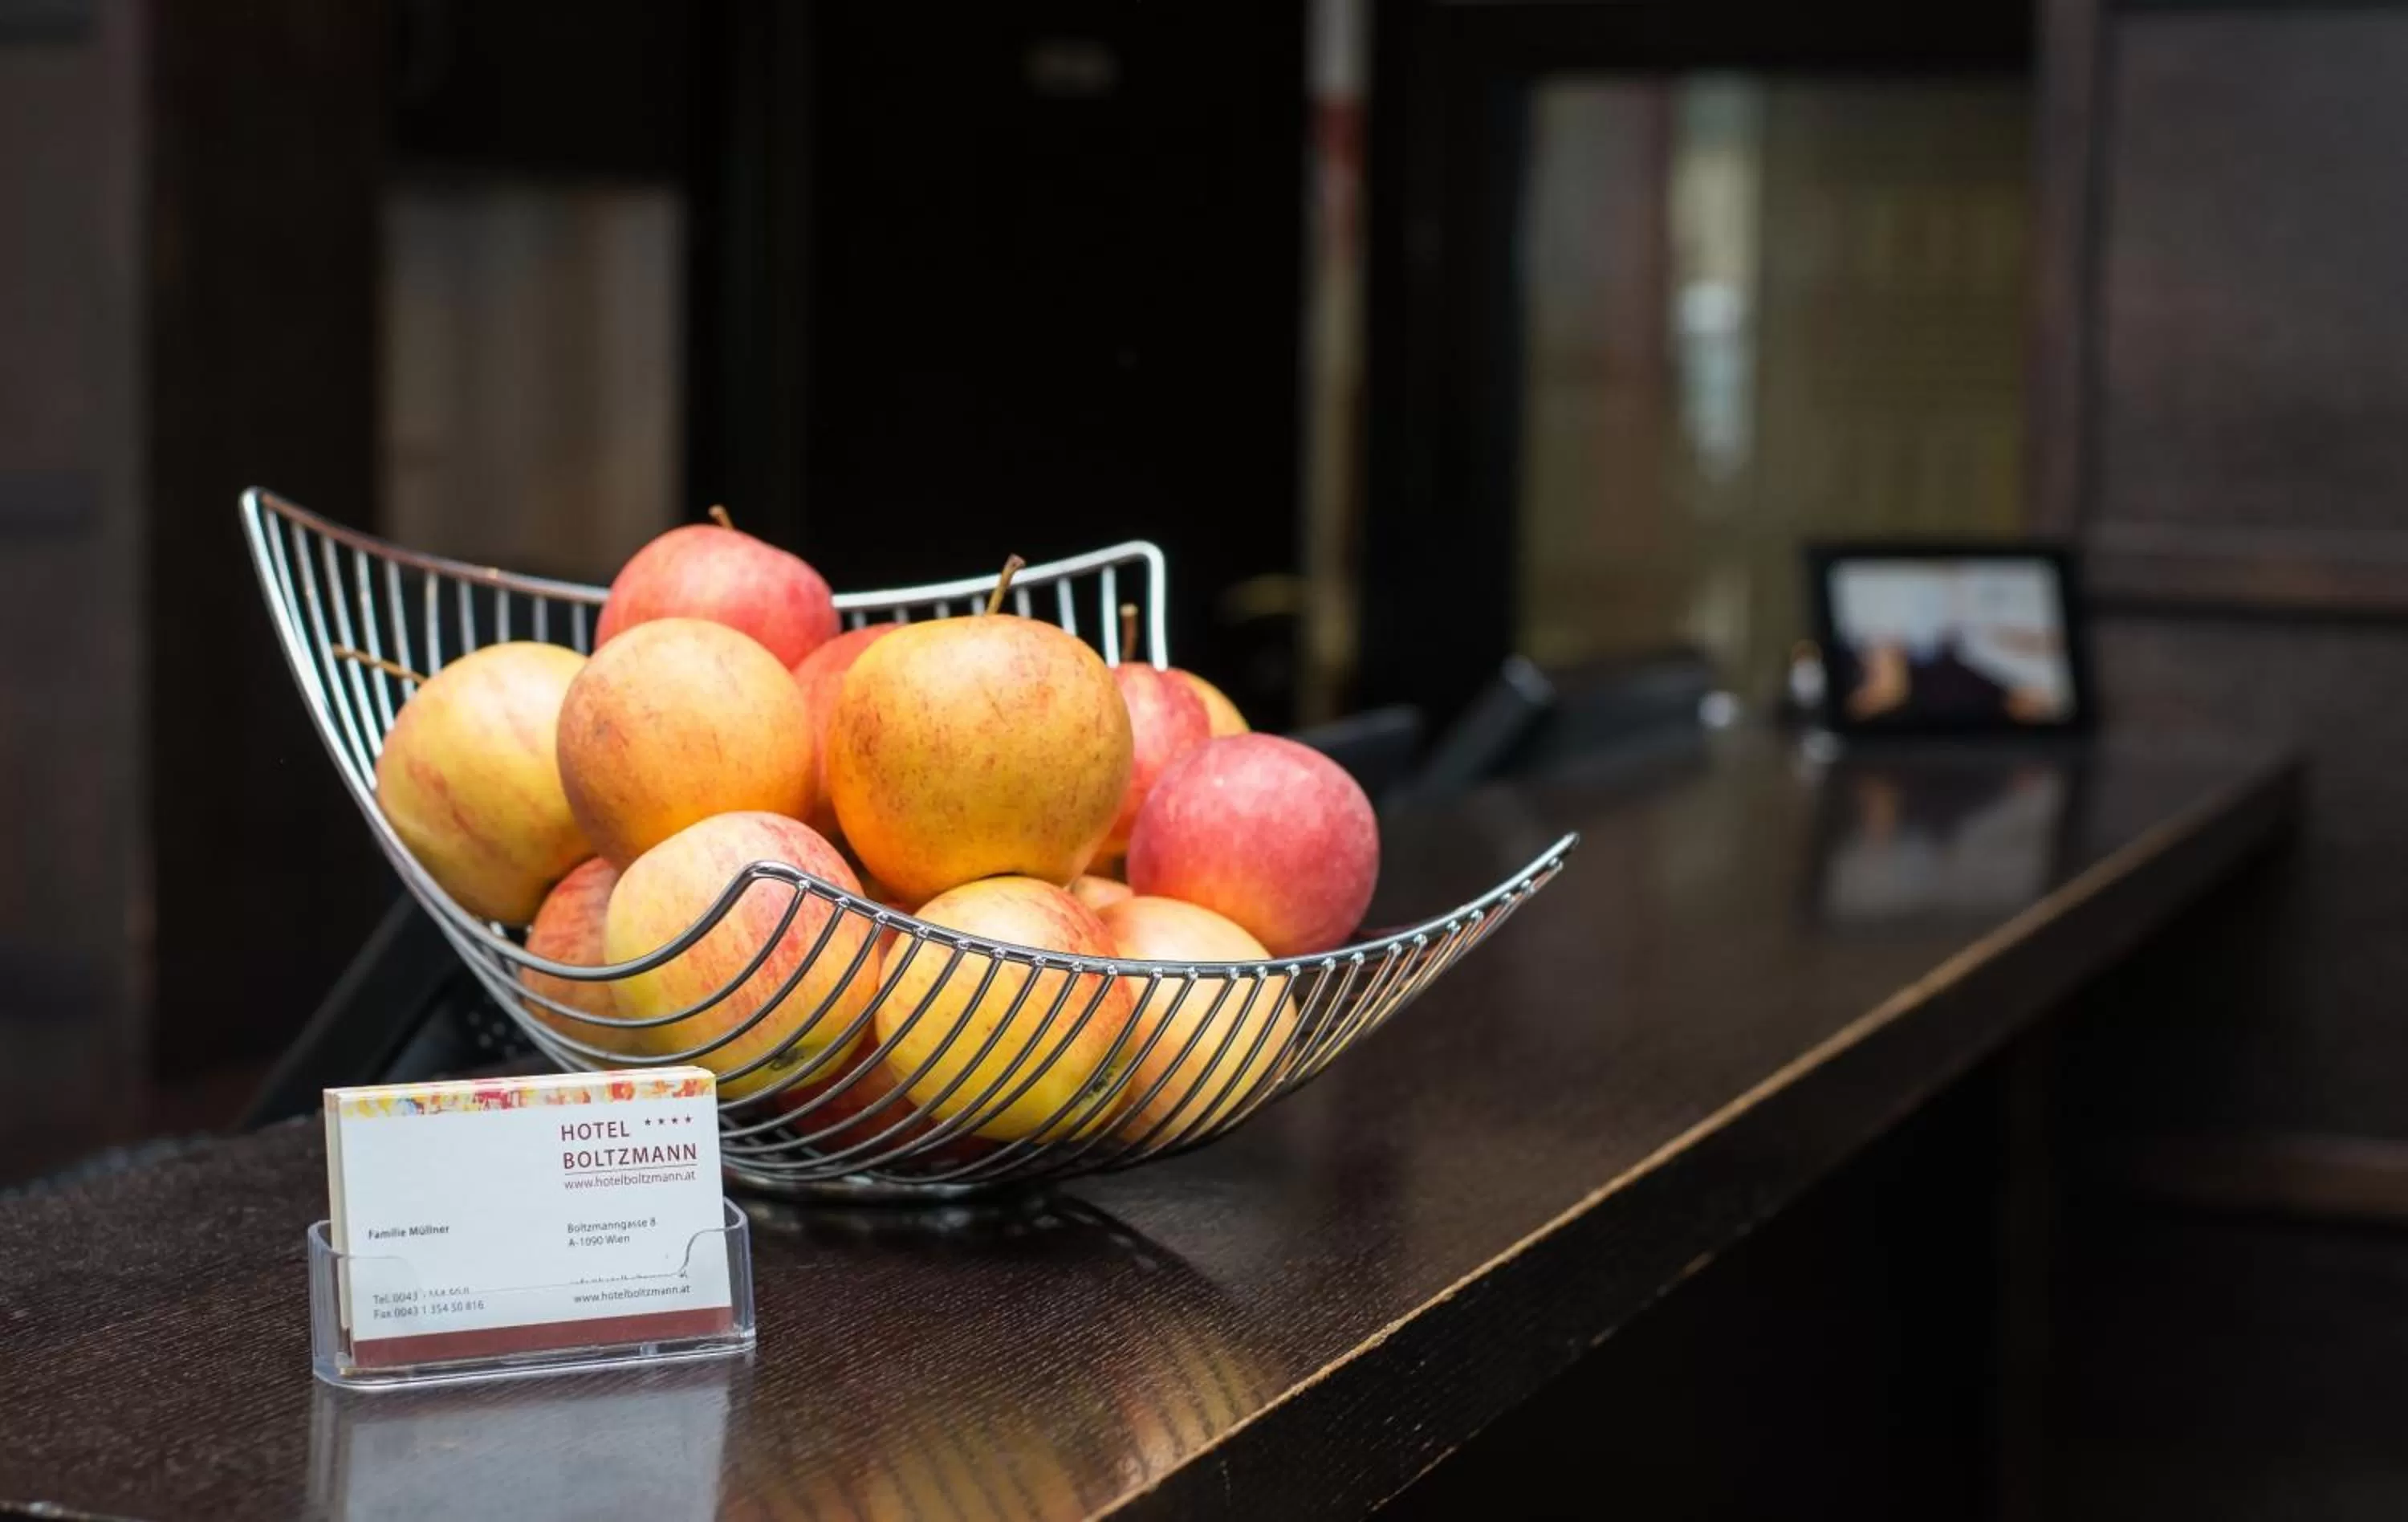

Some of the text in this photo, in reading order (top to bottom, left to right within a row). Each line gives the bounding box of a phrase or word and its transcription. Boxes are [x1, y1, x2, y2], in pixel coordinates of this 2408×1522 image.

[561, 1120, 630, 1142] HOTEL
[563, 1142, 698, 1170] BOLTZMANN
[564, 1171, 697, 1189] www.hotelboltzmann.at
[368, 1224, 450, 1240] Familie Müllner
[567, 1216, 657, 1234] Boltzmanngasse 8
[568, 1235, 630, 1247] A-1090 Wien
[392, 1291, 419, 1303] 0043
[573, 1284, 691, 1304] www.hotelboltzmann.at
[393, 1304, 419, 1318] 0043
[431, 1302, 449, 1314] 354
[450, 1300, 463, 1312] 50
